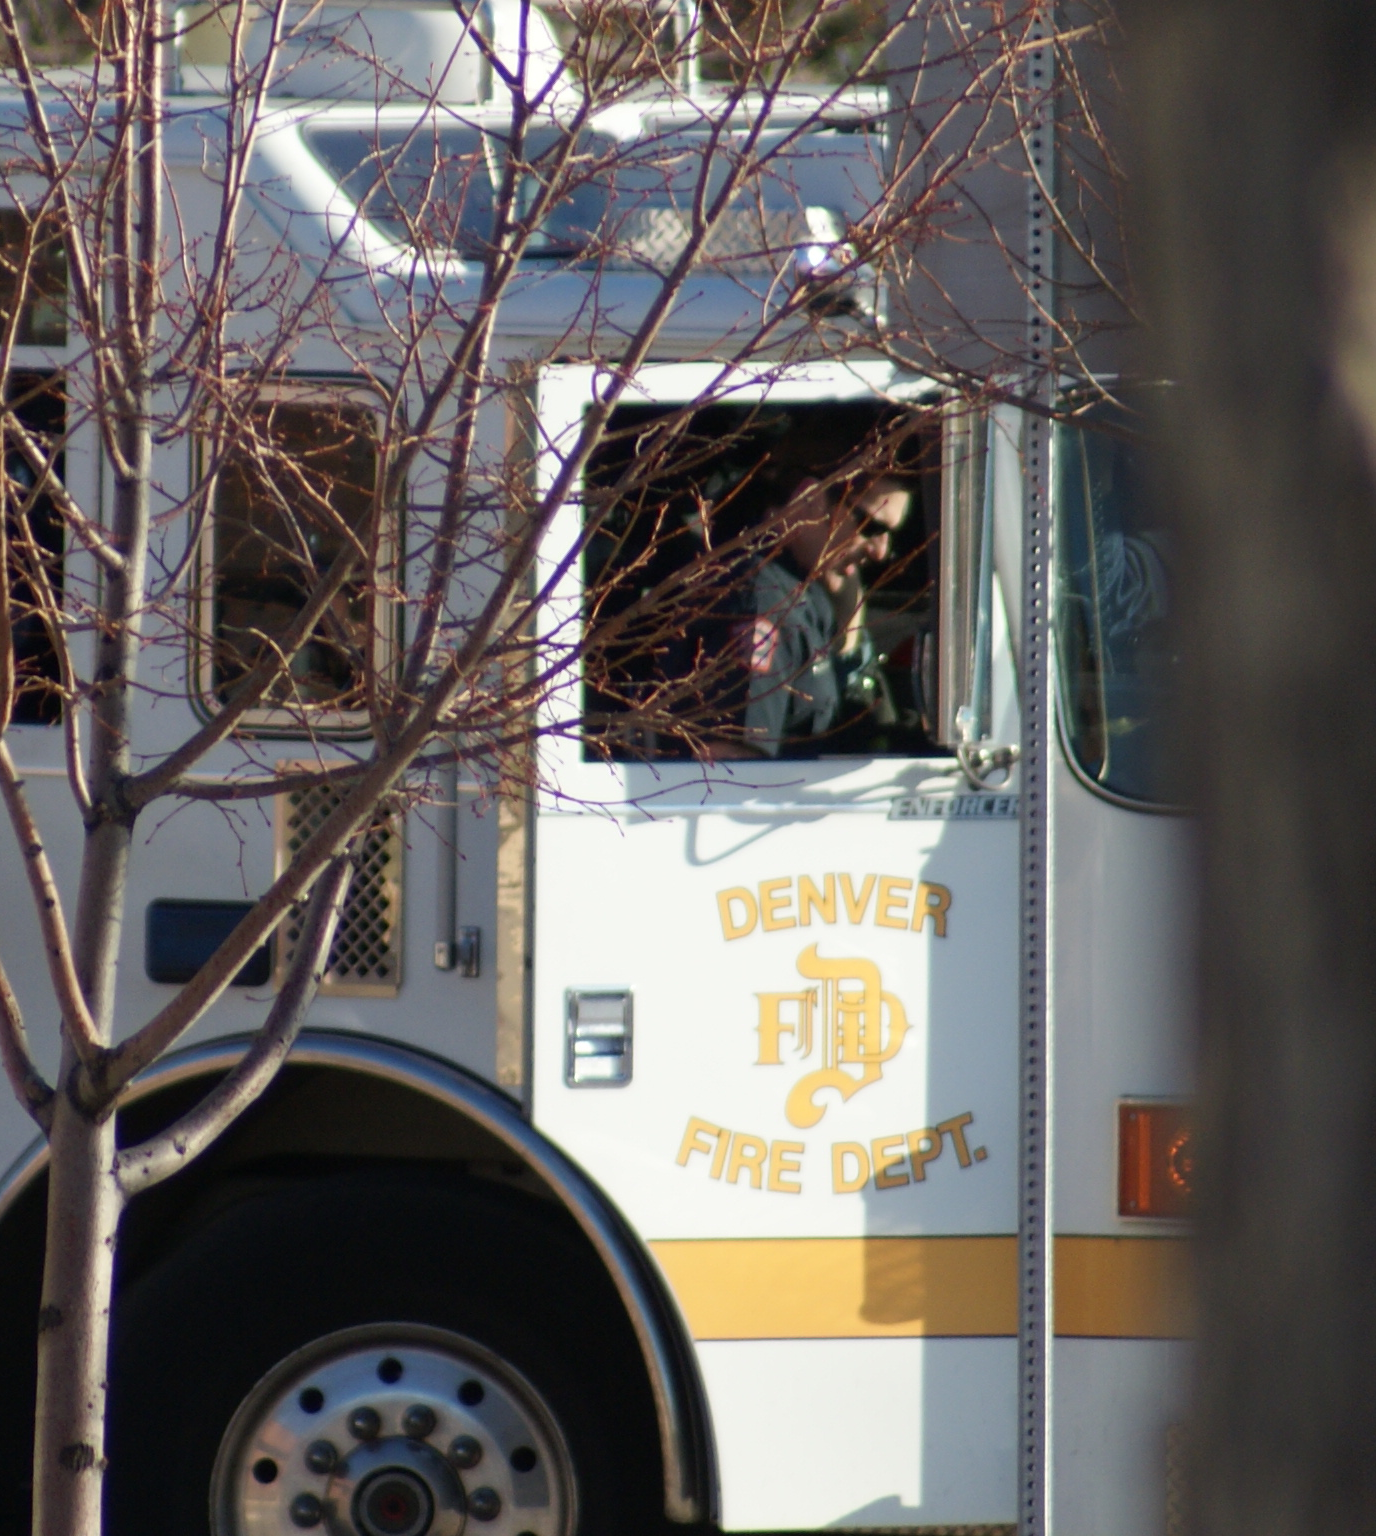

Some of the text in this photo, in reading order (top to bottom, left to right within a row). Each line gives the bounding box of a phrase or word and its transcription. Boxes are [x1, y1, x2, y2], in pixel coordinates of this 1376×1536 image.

[716, 872, 952, 942] DENVER
[675, 1111, 989, 1195] FIRE DEPT.
